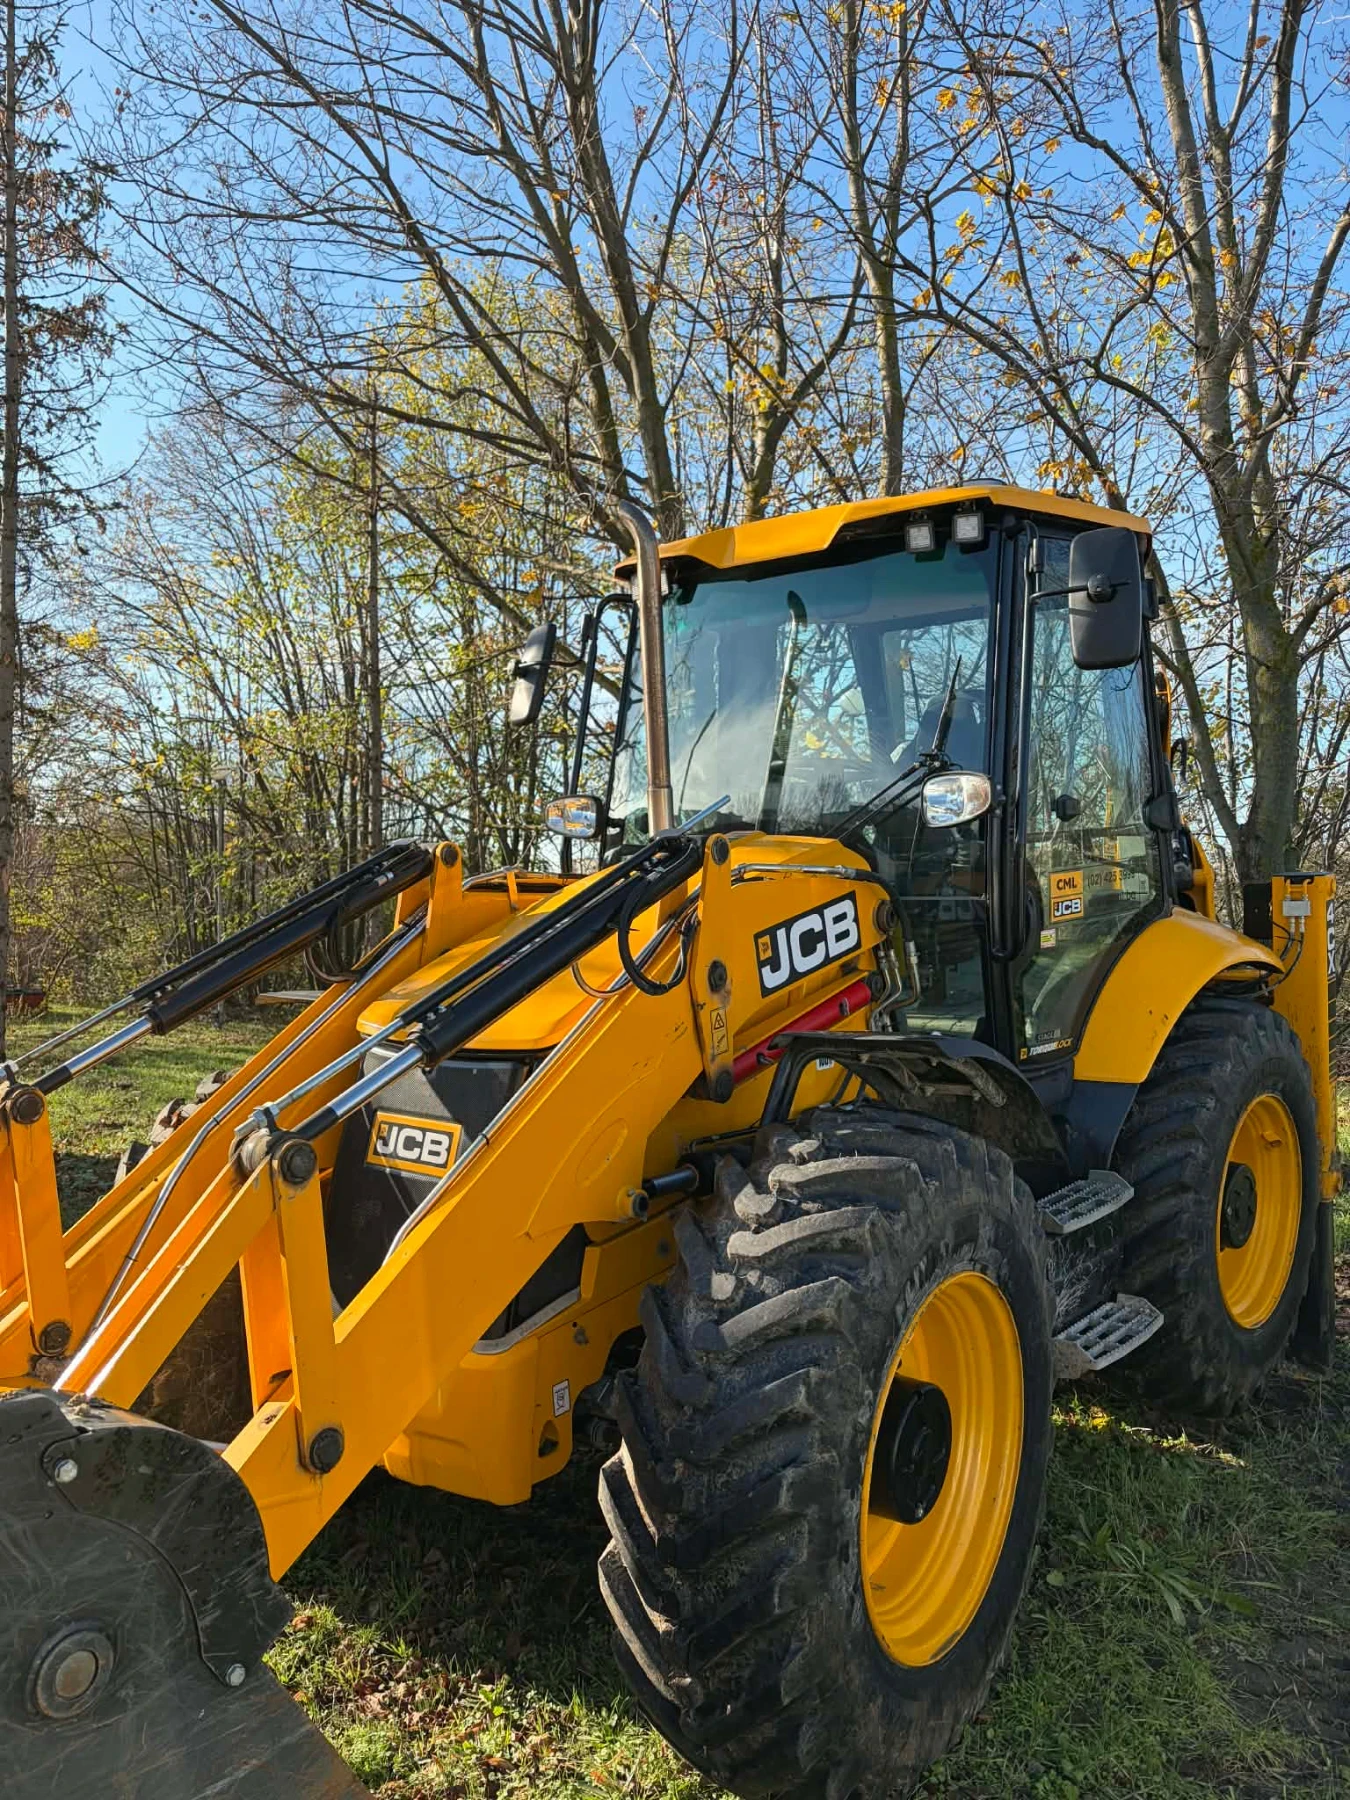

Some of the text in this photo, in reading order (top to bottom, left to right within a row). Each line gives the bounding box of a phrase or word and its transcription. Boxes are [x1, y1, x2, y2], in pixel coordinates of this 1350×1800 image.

[1056, 877, 1077, 891] CML
[1054, 899, 1081, 917] JCB
[762, 900, 858, 988] JCB
[1327, 902, 1336, 974] 4CX
[376, 1125, 450, 1165] JCB
